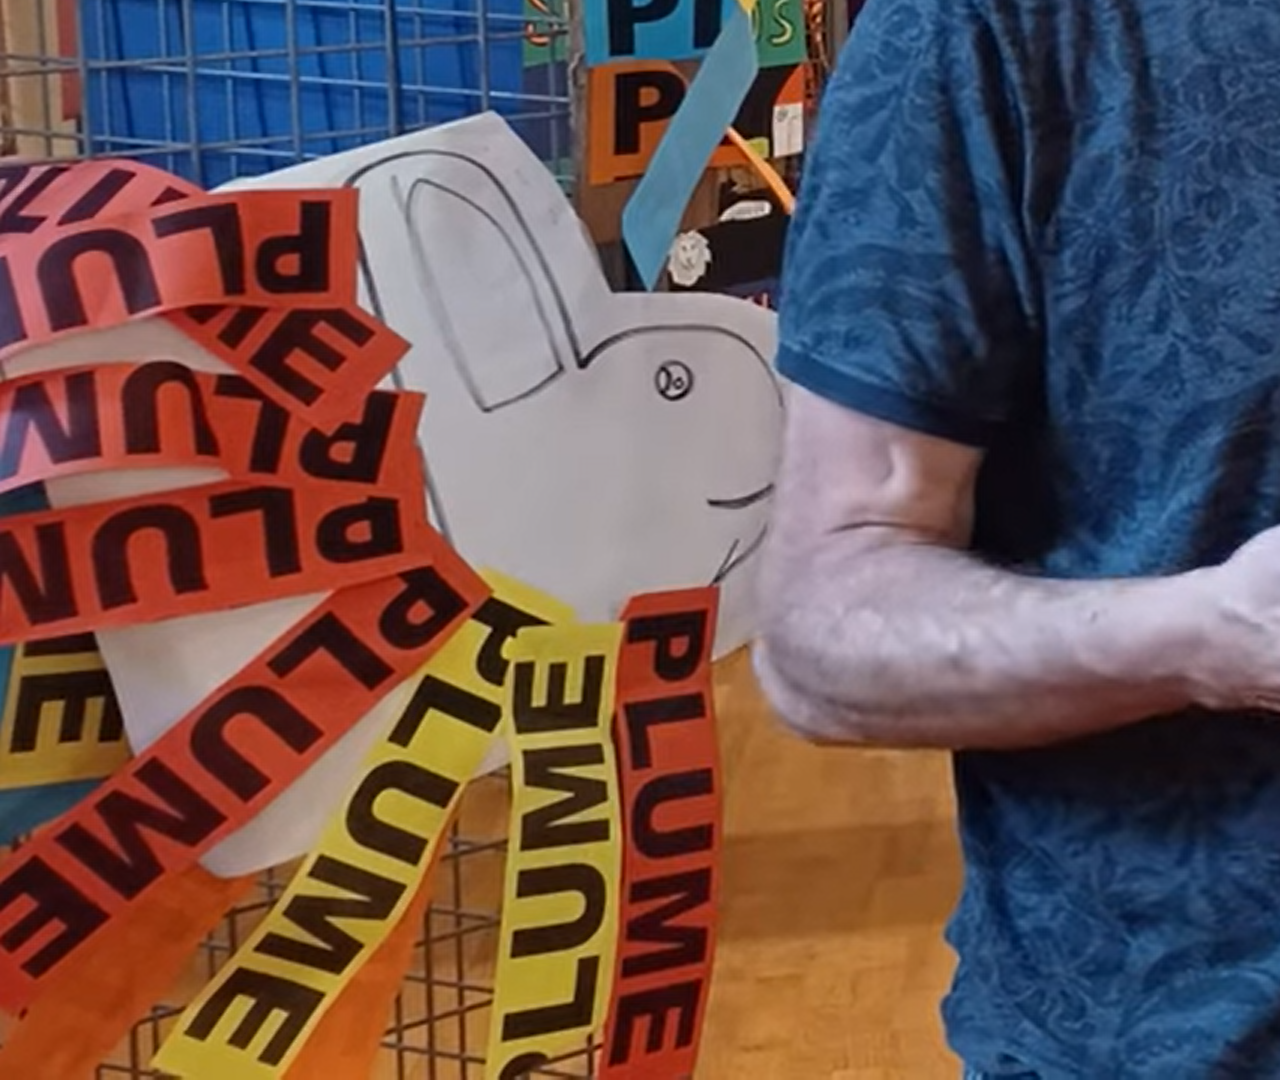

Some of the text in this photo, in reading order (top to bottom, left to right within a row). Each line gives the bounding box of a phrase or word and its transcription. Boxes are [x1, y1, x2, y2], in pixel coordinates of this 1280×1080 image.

[0, 566, 470, 980] PLUME
[186, 596, 553, 1066] PLUME
[609, 610, 714, 1069] PLUME
